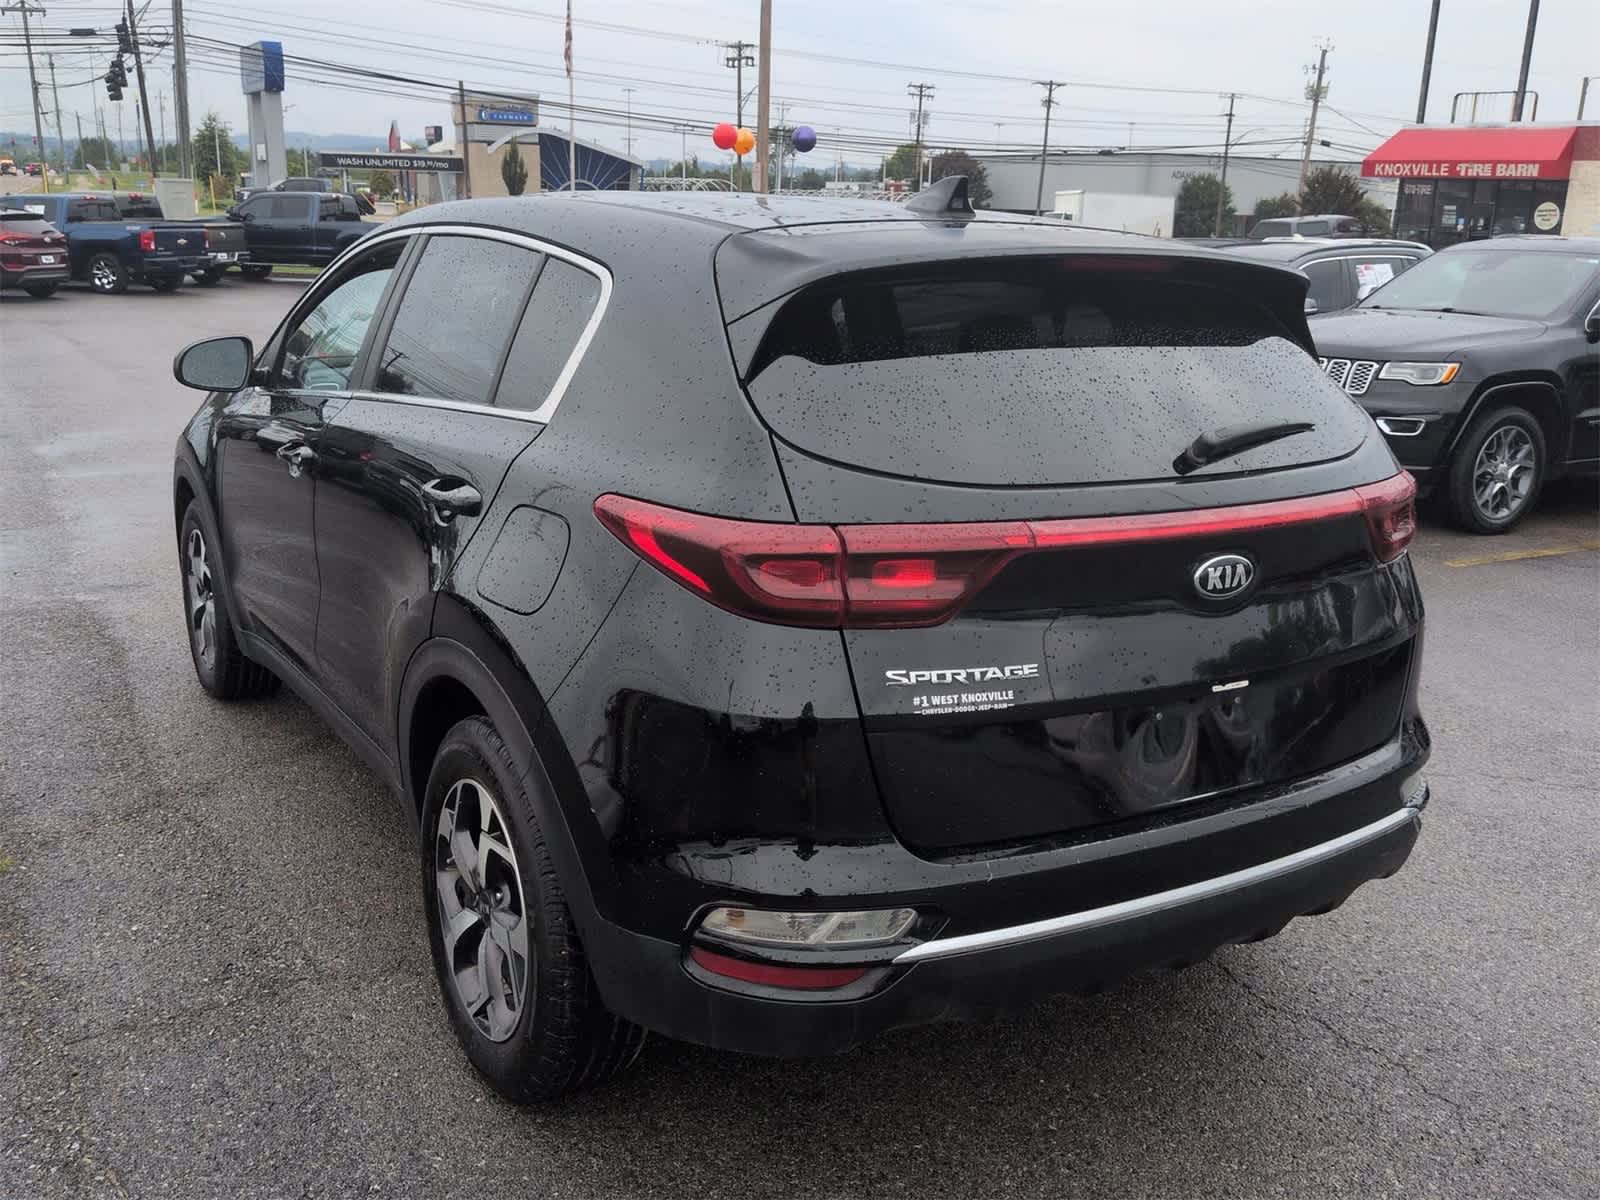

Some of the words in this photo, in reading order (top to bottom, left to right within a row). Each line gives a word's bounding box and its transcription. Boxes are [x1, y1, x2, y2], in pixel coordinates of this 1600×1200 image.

[337, 157, 364, 166] WASH
[364, 157, 410, 168] UNLIMITED
[1374, 162, 1449, 176] KNOXVILLE
[1495, 163, 1539, 177] BARN
[1207, 563, 1247, 591] KIA
[885, 663, 1040, 686] SPORTAGE
[913, 695, 930, 707] #1
[931, 694, 959, 706] WEST
[961, 690, 1014, 704] KNOXVILLE
